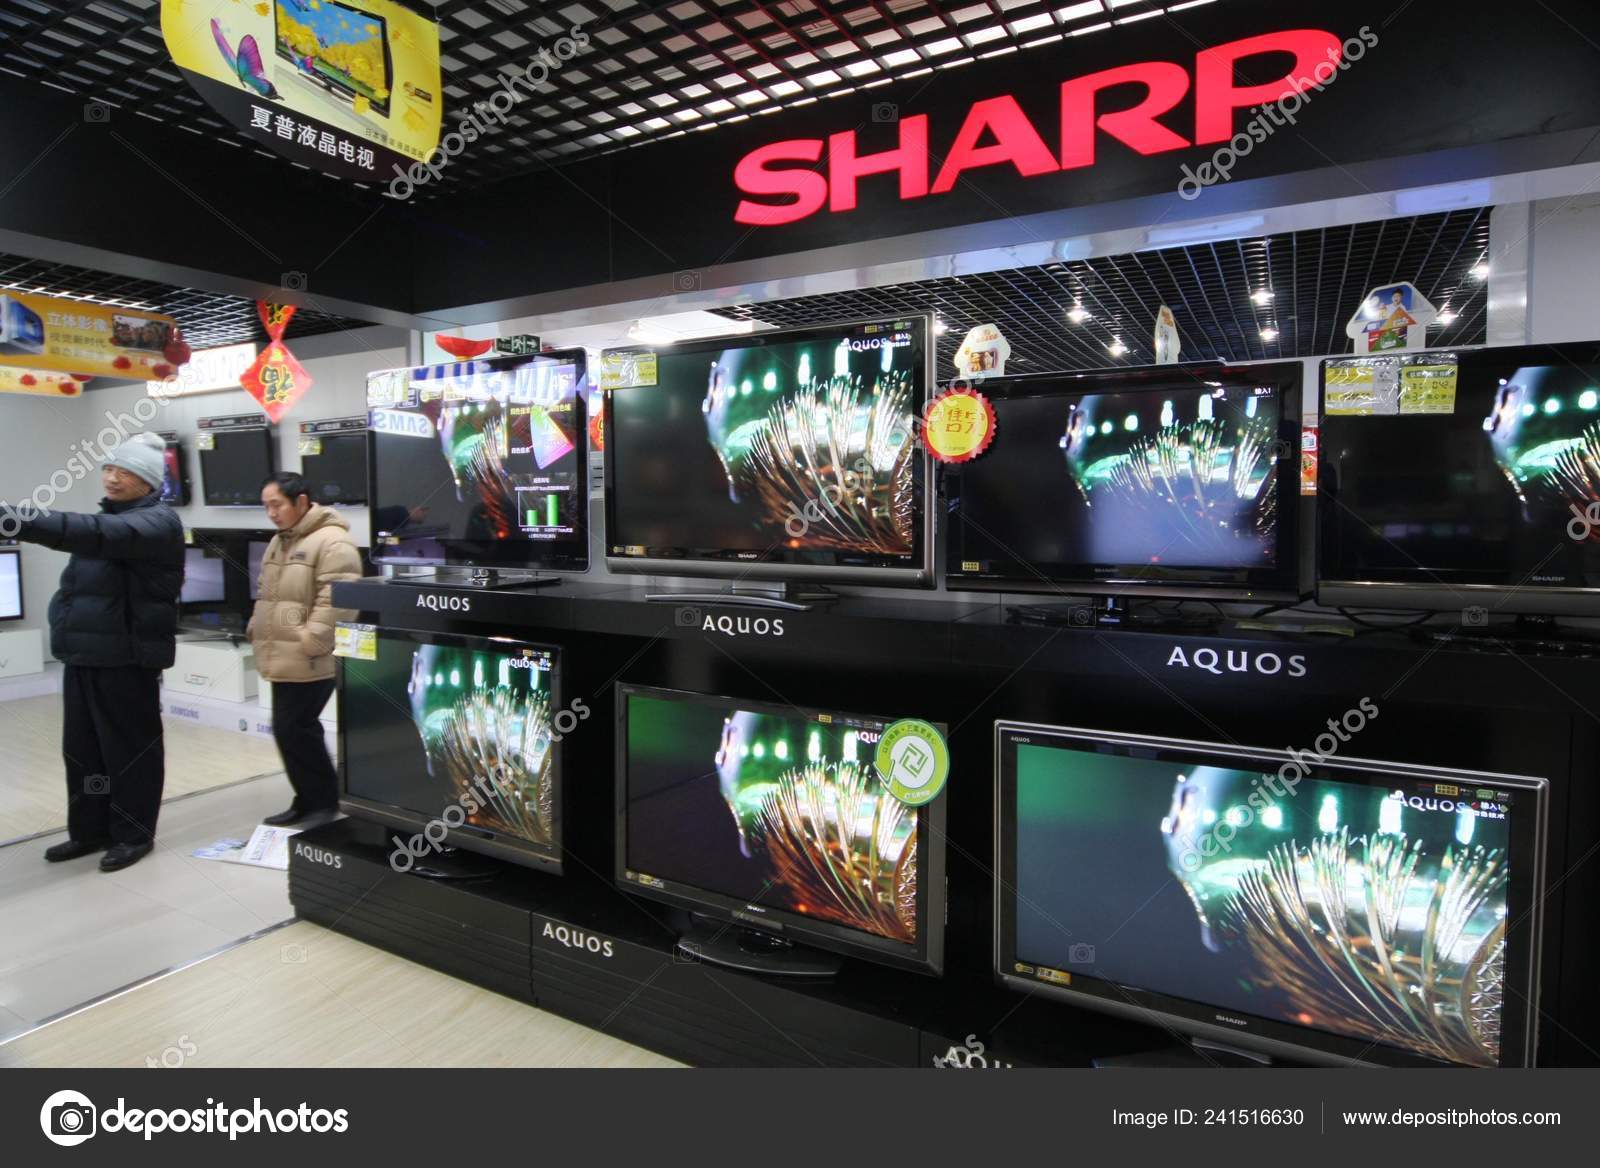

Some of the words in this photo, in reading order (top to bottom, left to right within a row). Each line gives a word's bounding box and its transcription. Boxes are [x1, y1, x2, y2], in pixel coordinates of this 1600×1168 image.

[250, 103, 376, 171] 夏普液晶电视
[733, 28, 1342, 226] SHARP
[416, 594, 470, 613] AQUOS
[702, 615, 785, 636] AQUOS
[1167, 646, 1306, 677] AQUOS
[854, 731, 881, 744] AQU
[295, 844, 342, 869] AQUOS
[543, 922, 614, 958] AQUOS
